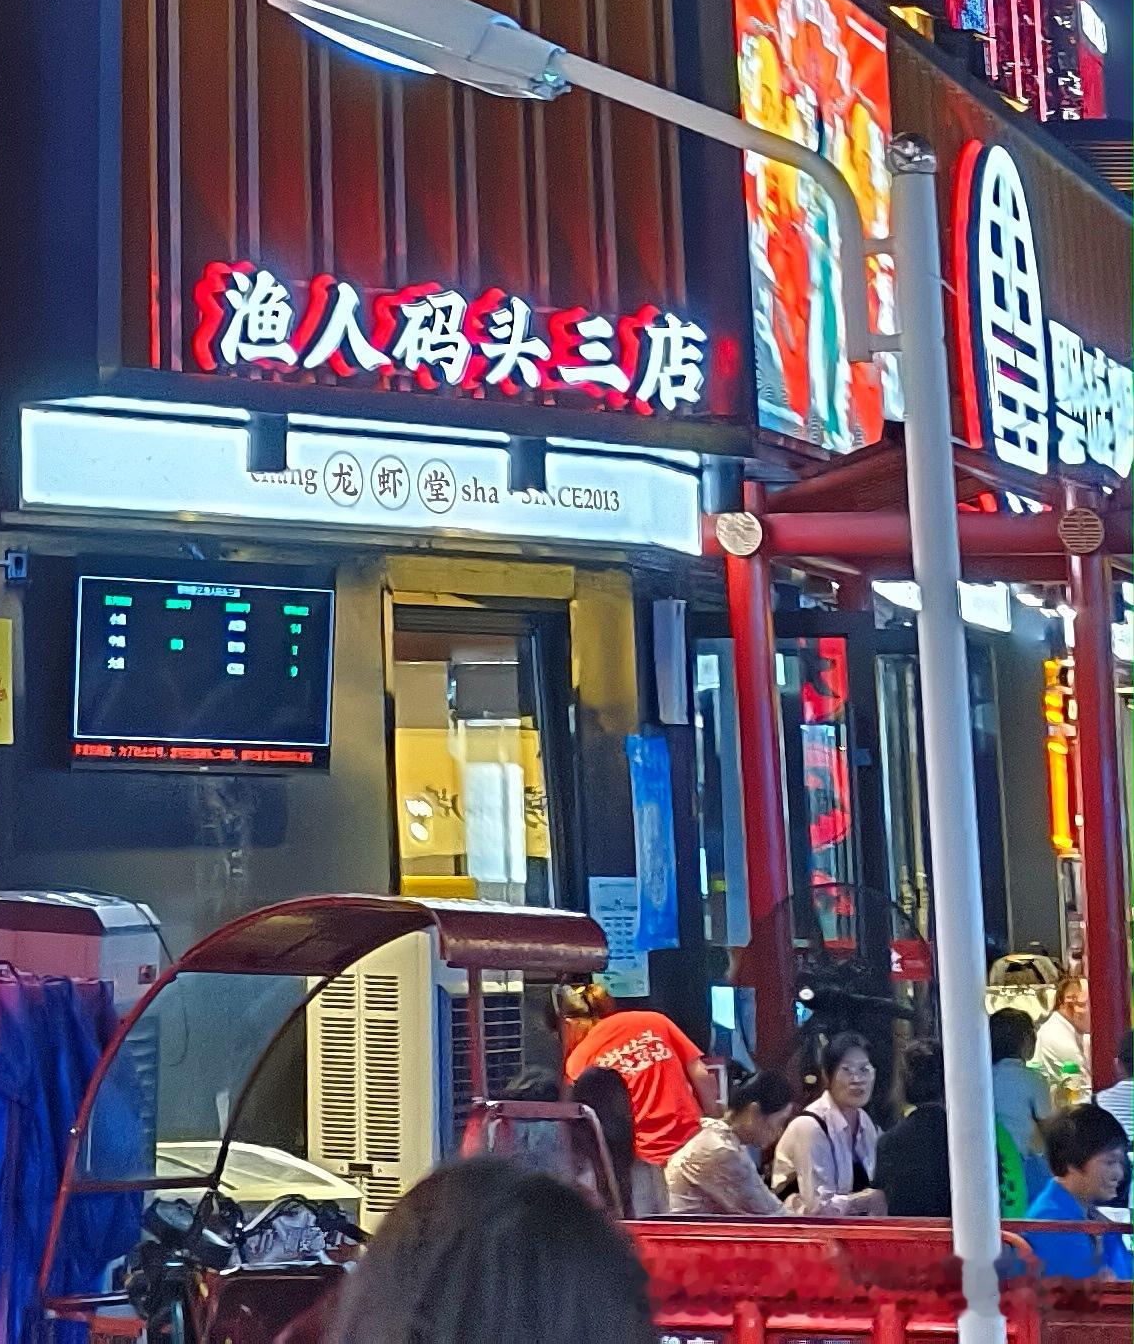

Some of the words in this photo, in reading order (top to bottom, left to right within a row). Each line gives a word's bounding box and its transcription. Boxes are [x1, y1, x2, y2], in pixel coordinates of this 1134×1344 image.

[220, 270, 708, 411] 渔人码头三店
[329, 461, 451, 503] 龙虾堂
[461, 477, 500, 504] sha
